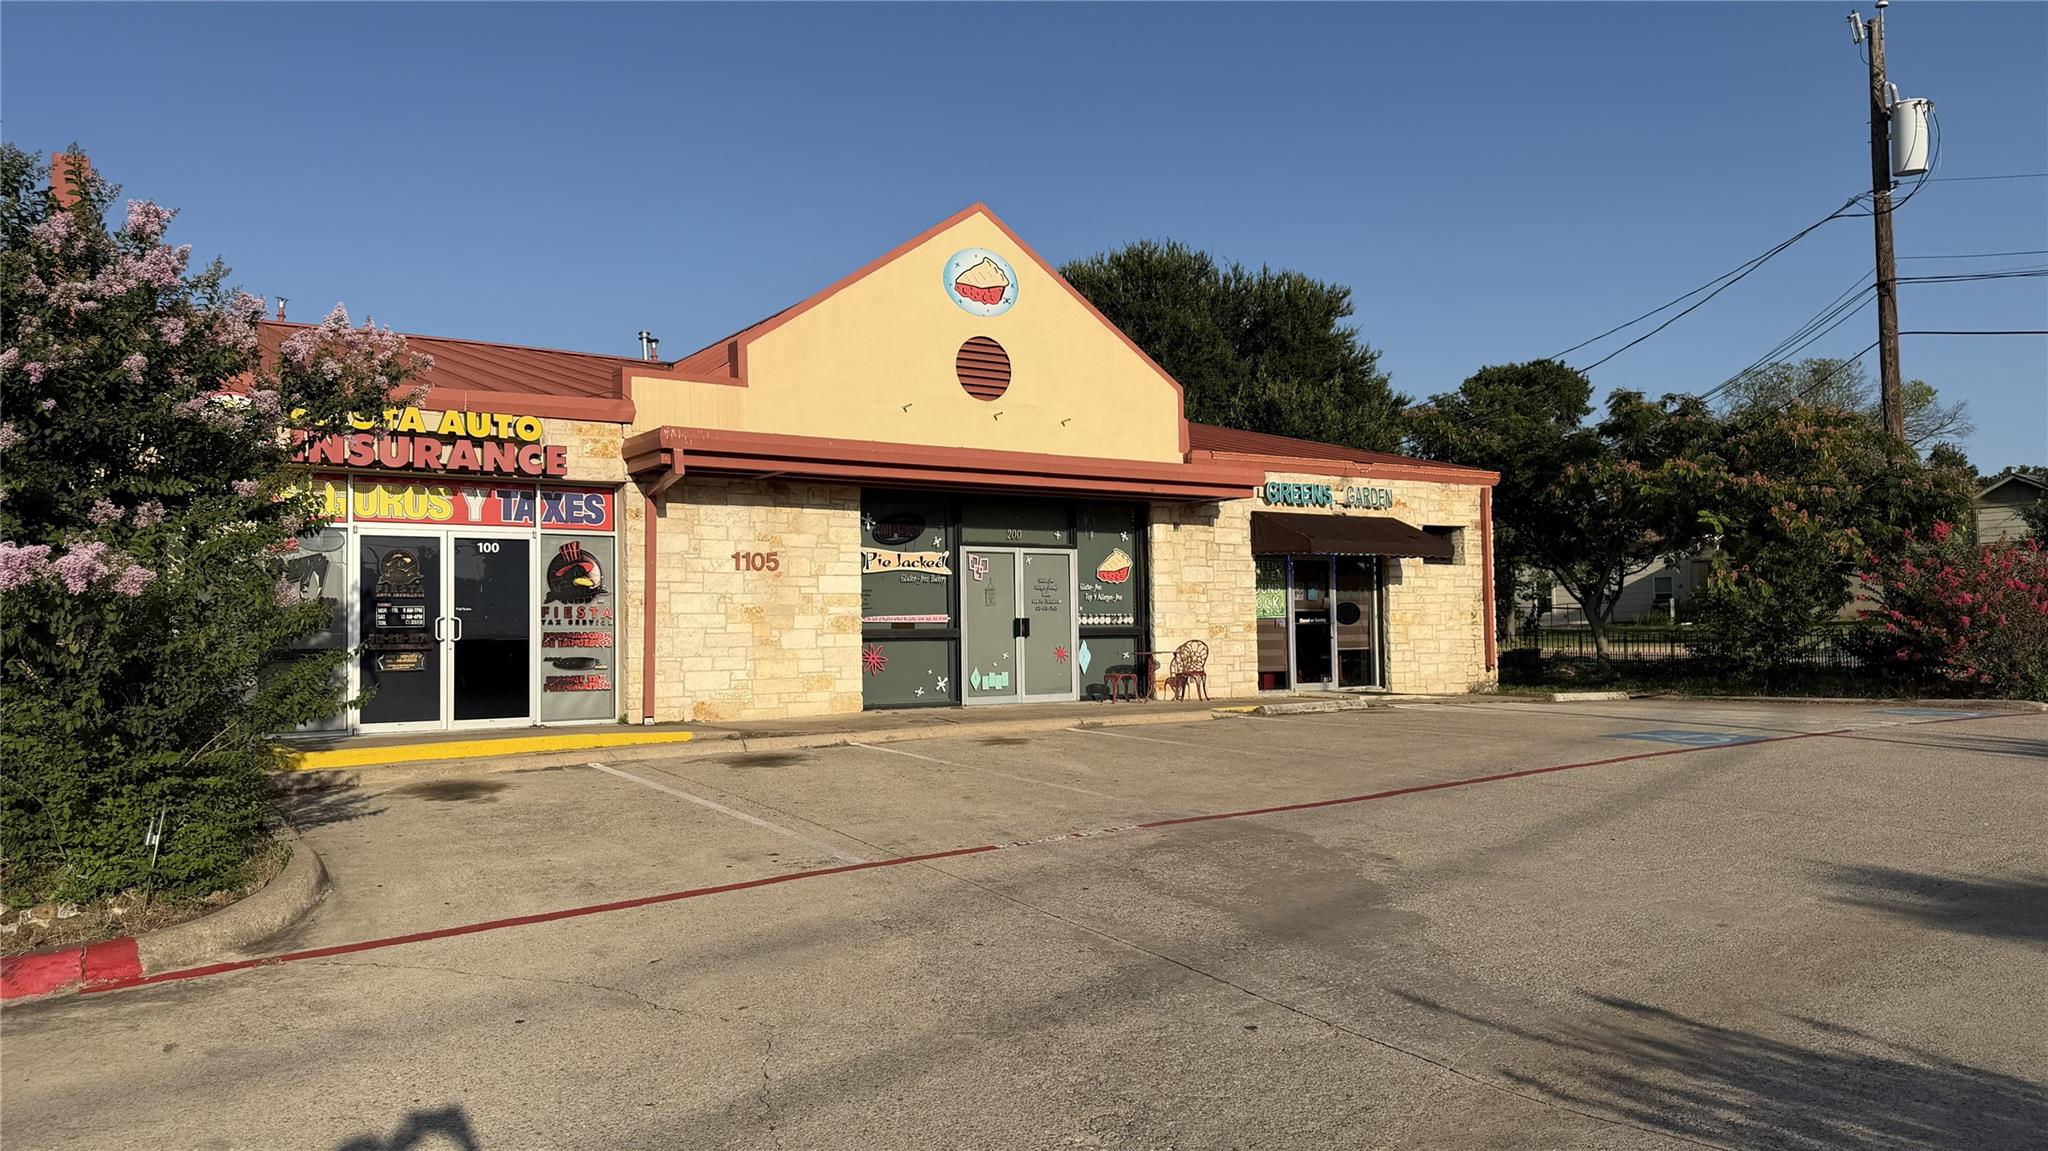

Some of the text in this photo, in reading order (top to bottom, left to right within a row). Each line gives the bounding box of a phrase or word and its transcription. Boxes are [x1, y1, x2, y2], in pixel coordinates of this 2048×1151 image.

[438, 409, 542, 442] AUTO
[291, 429, 568, 476] INSURANCE
[1266, 481, 1393, 509] GREENS GARDEN
[460, 486, 491, 521] Y
[496, 489, 606, 526] TAXES
[1007, 528, 1022, 540] 200
[477, 542, 500, 553] 100
[731, 551, 780, 572] 1105
[865, 551, 947, 570] Pie Jacked
[541, 606, 612, 619] FIESTA
